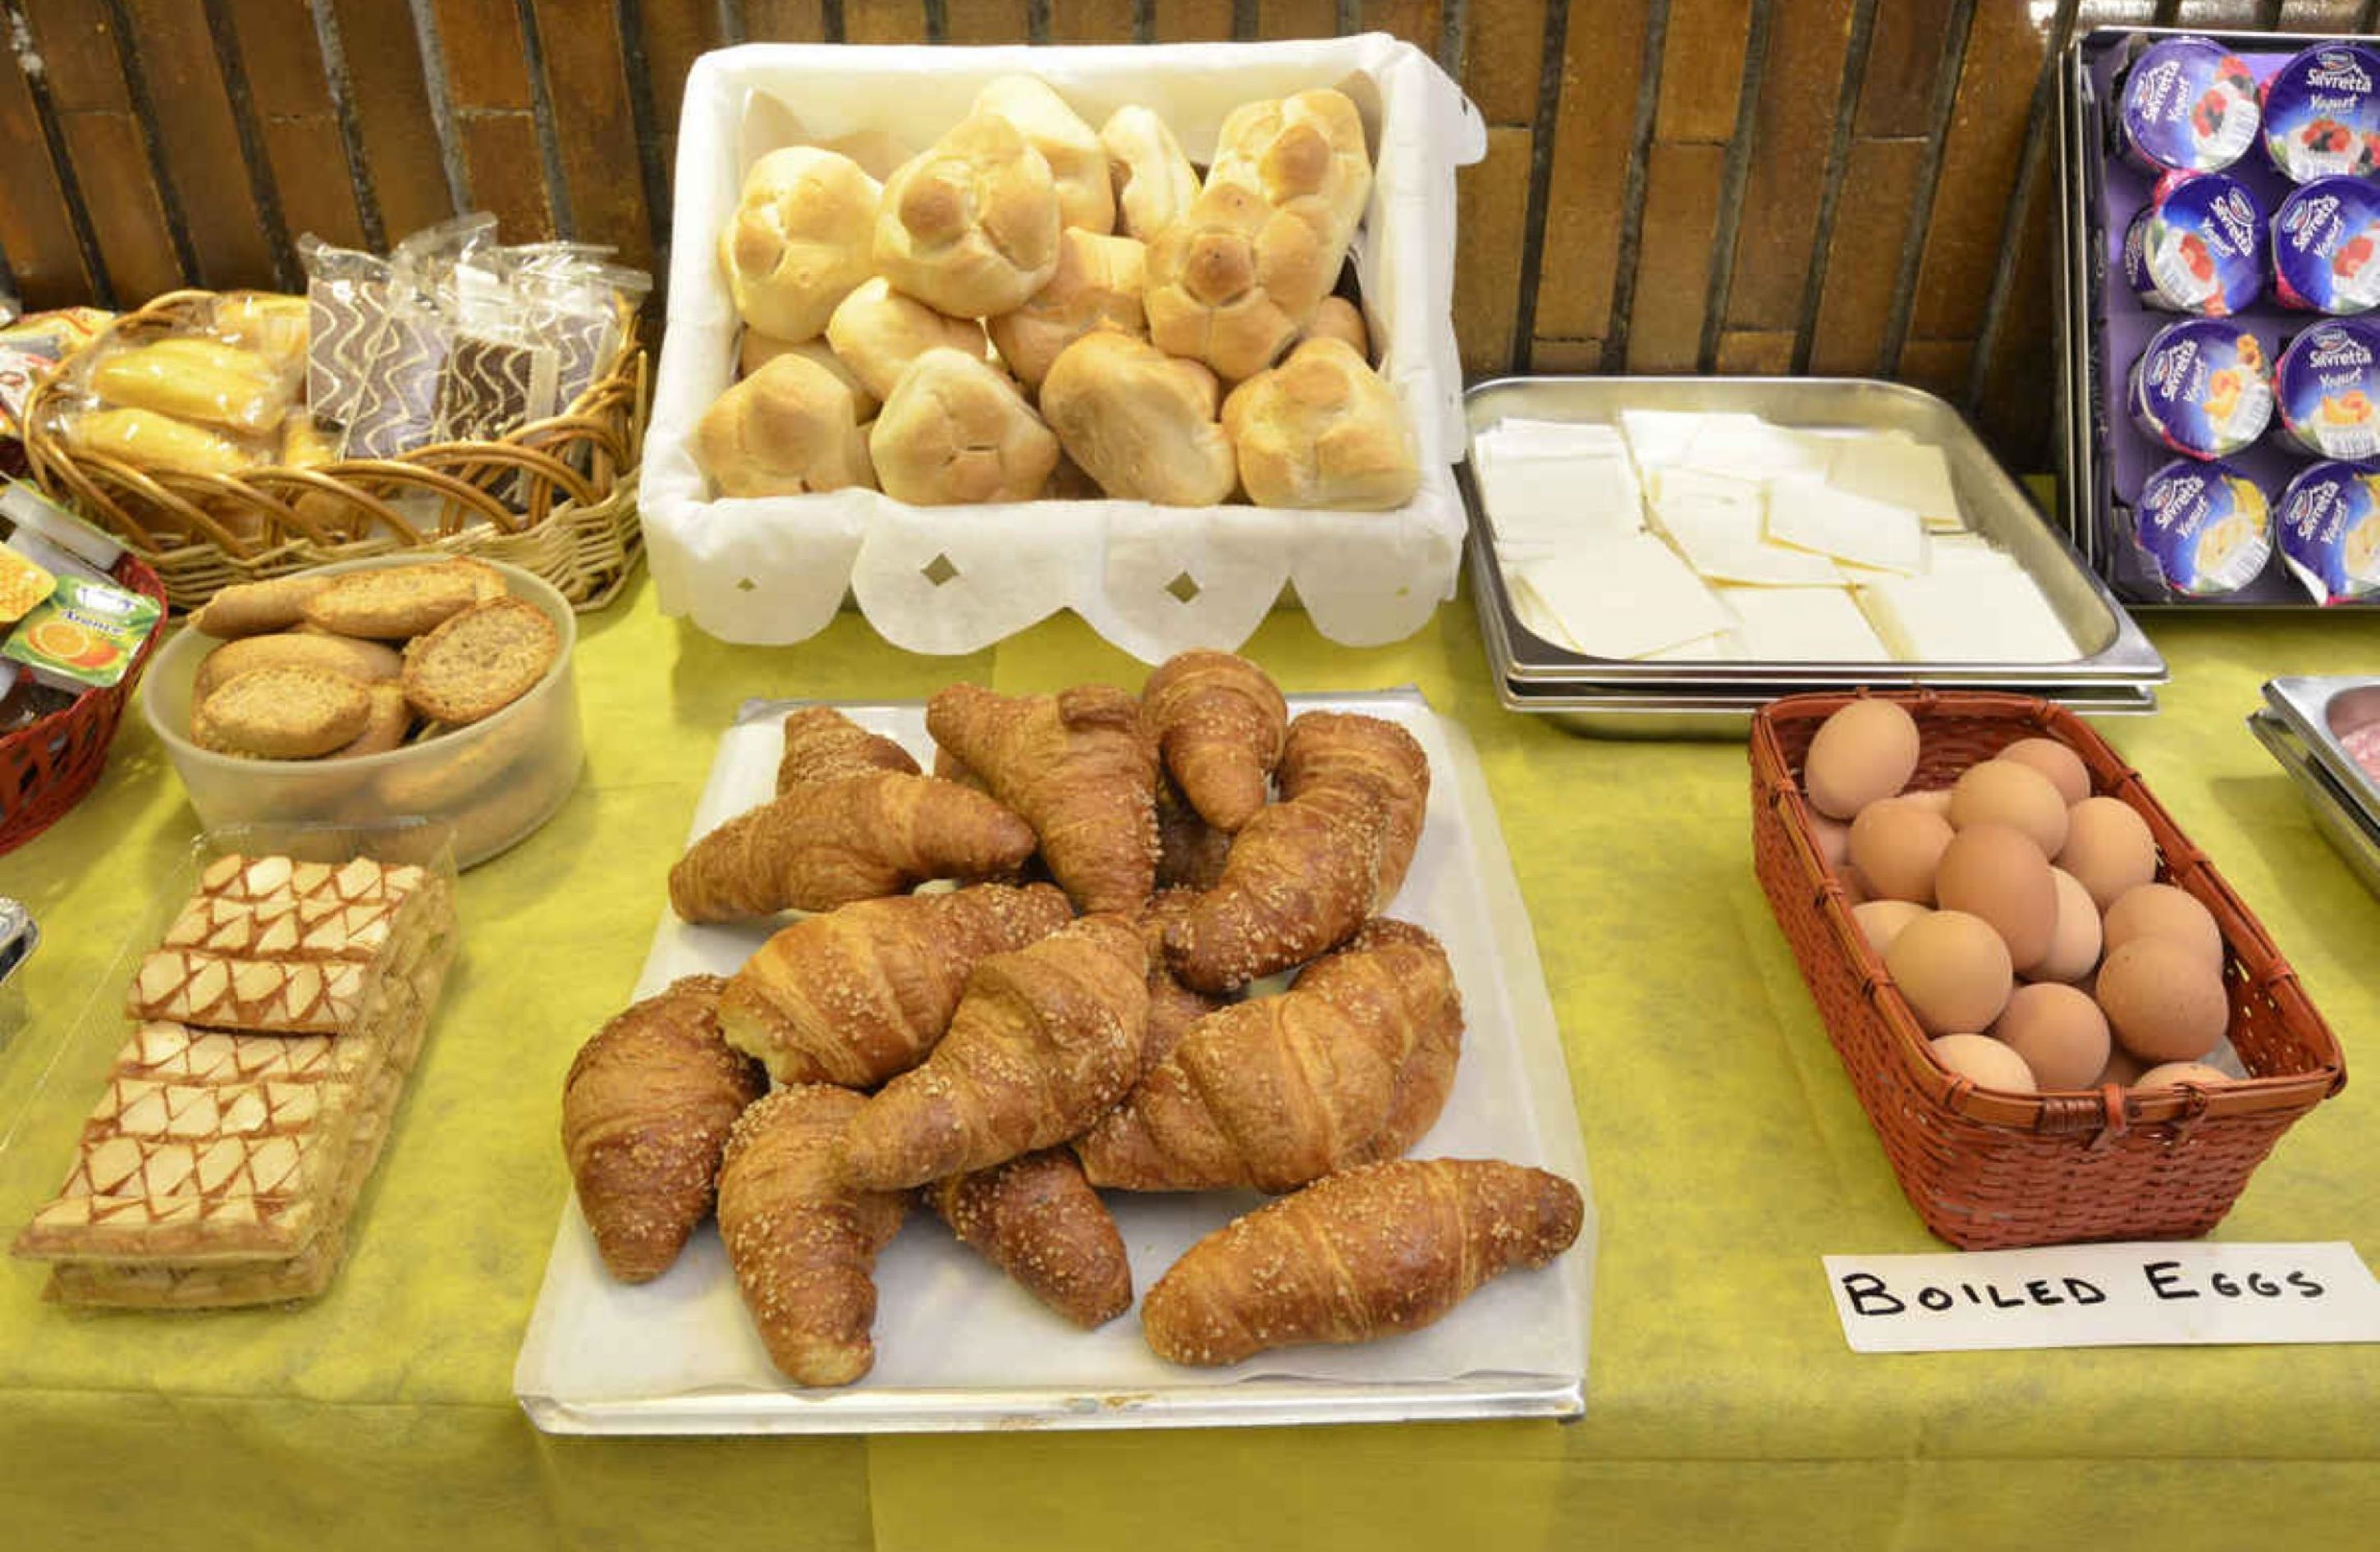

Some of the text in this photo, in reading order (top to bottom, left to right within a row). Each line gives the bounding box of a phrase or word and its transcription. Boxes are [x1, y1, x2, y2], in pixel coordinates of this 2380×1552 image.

[2306, 64, 2372, 93] Silvretta
[2310, 93, 2359, 112] Yogurt
[2310, 338, 2372, 367] Silvretta
[1842, 1261, 2325, 1316] BOILED EGGS
